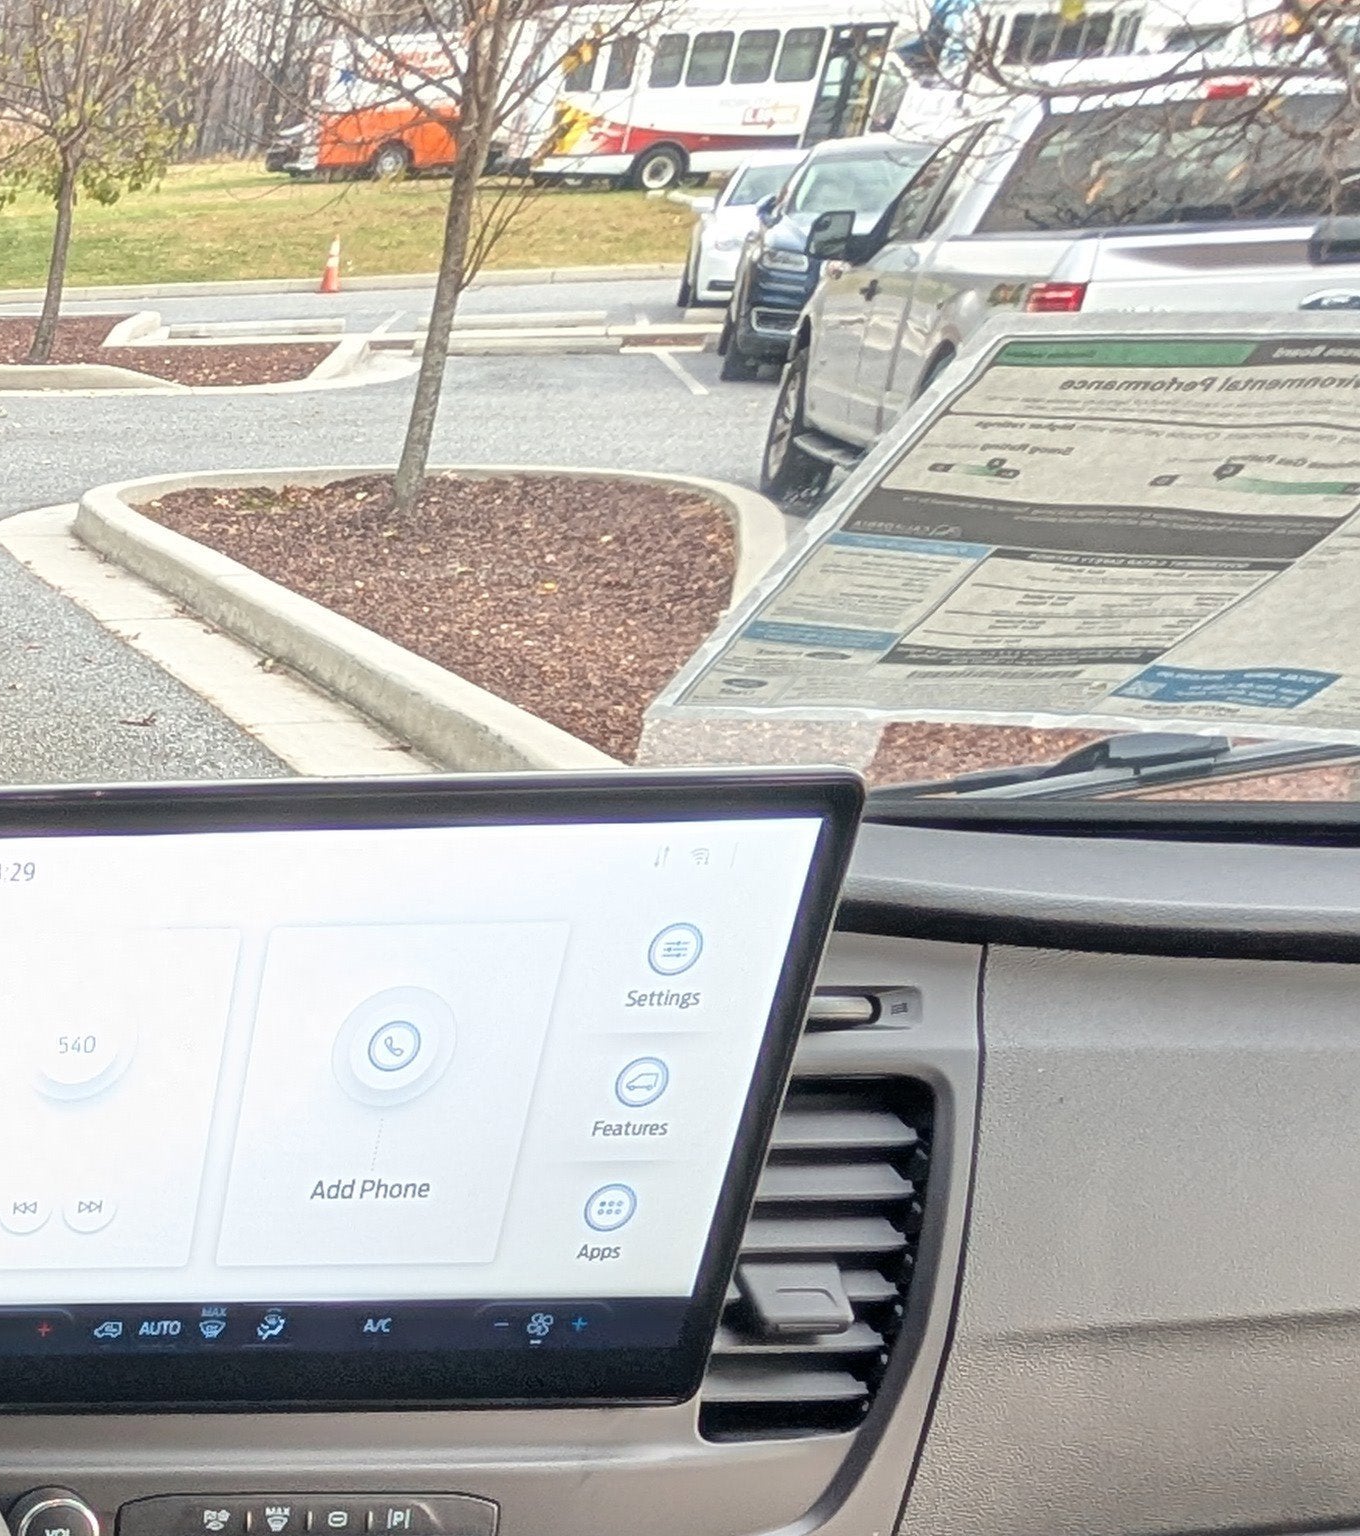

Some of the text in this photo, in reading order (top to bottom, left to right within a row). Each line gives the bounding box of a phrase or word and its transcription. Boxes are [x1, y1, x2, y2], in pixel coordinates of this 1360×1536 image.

[625, 989, 701, 1009] Settings
[58, 1035, 97, 1055] 540
[591, 1120, 669, 1138] Features
[310, 1178, 431, 1200] Add Phone
[576, 1243, 621, 1262] Apps
[200, 1306, 227, 1318] MAX
[138, 1320, 181, 1336] AUTO
[362, 1318, 392, 1333] A/C
[265, 1507, 290, 1517] MAX
